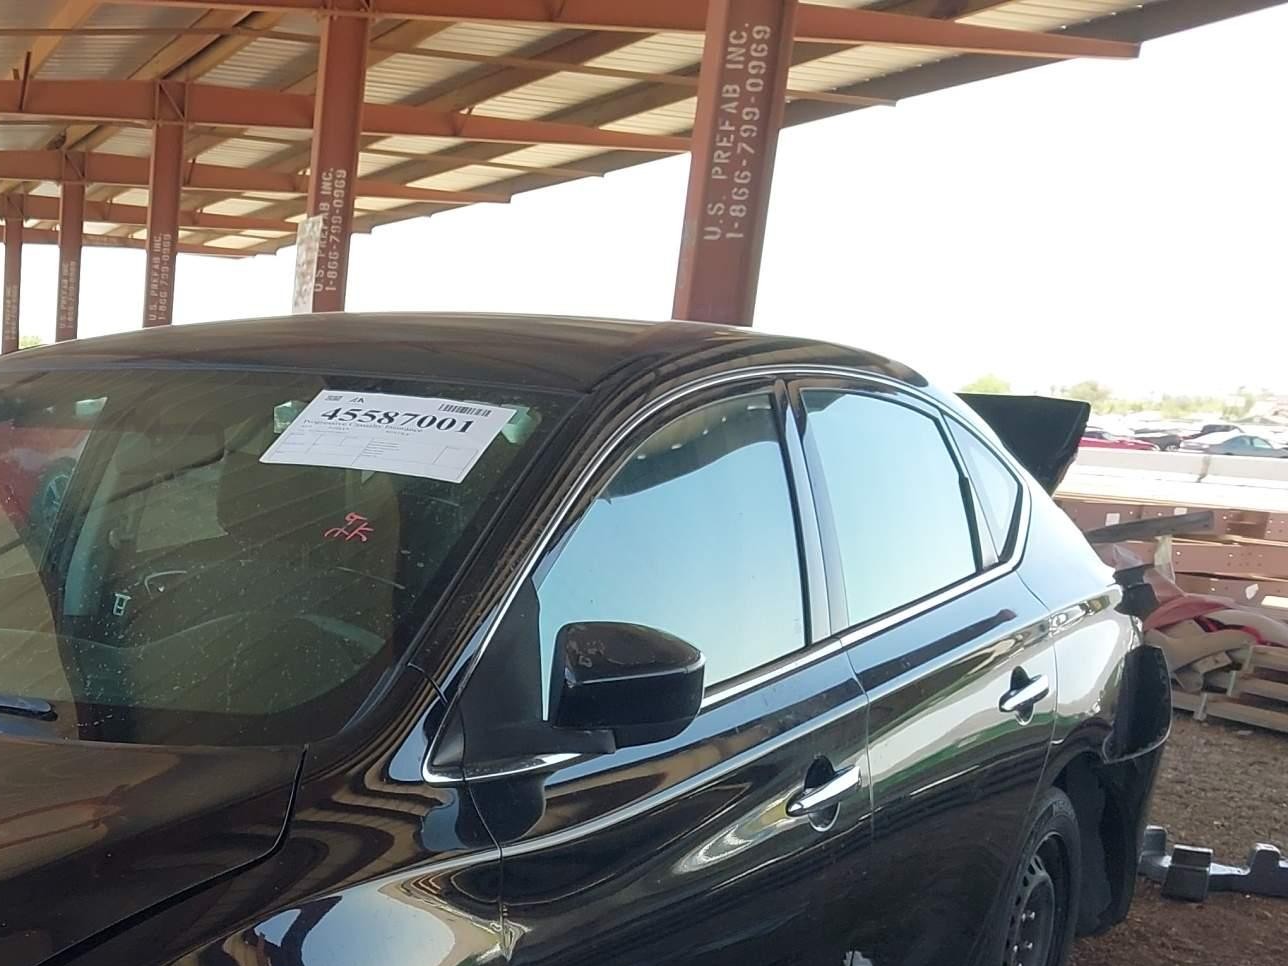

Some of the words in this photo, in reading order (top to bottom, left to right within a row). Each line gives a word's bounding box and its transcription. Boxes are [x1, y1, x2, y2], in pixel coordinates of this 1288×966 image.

[725, 23, 749, 69] INC.
[711, 83, 740, 179] PREFAB
[725, 24, 771, 239] 1-866-799-0969
[320, 168, 333, 195] INC.
[325, 169, 347, 291] 1-866-799-0969
[704, 195, 726, 240] U.S.
[150, 256, 160, 297] PREFAB
[320, 407, 475, 433] 45587001
